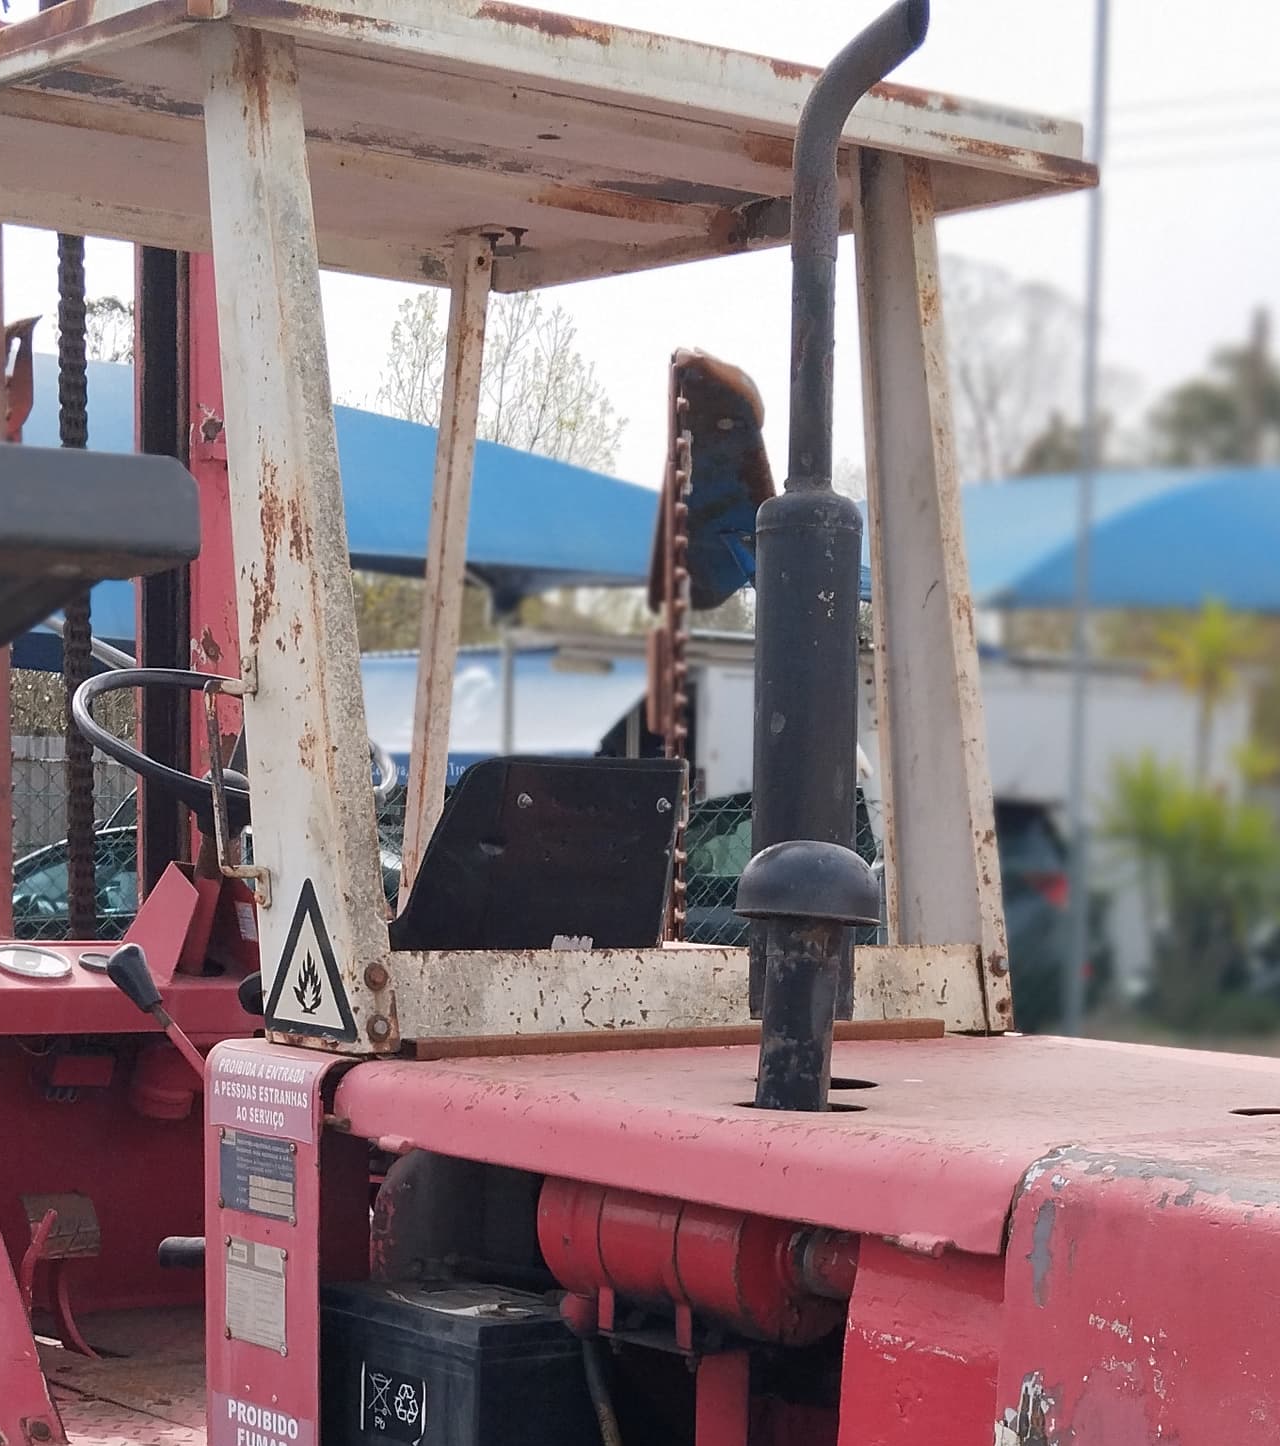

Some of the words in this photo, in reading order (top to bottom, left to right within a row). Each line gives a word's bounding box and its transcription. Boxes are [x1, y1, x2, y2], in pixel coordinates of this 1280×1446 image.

[218, 1058, 256, 1077] PROIBIDA
[257, 1063, 265, 1079] A
[264, 1064, 307, 1085] ENTRADA
[214, 1080, 220, 1096] A
[221, 1080, 257, 1101] PESSOAS
[258, 1086, 308, 1109] ESTRANHAS
[236, 1105, 248, 1121] AO
[249, 1107, 285, 1131] SERVIÇO
[227, 1399, 298, 1440] PROIBIDO
